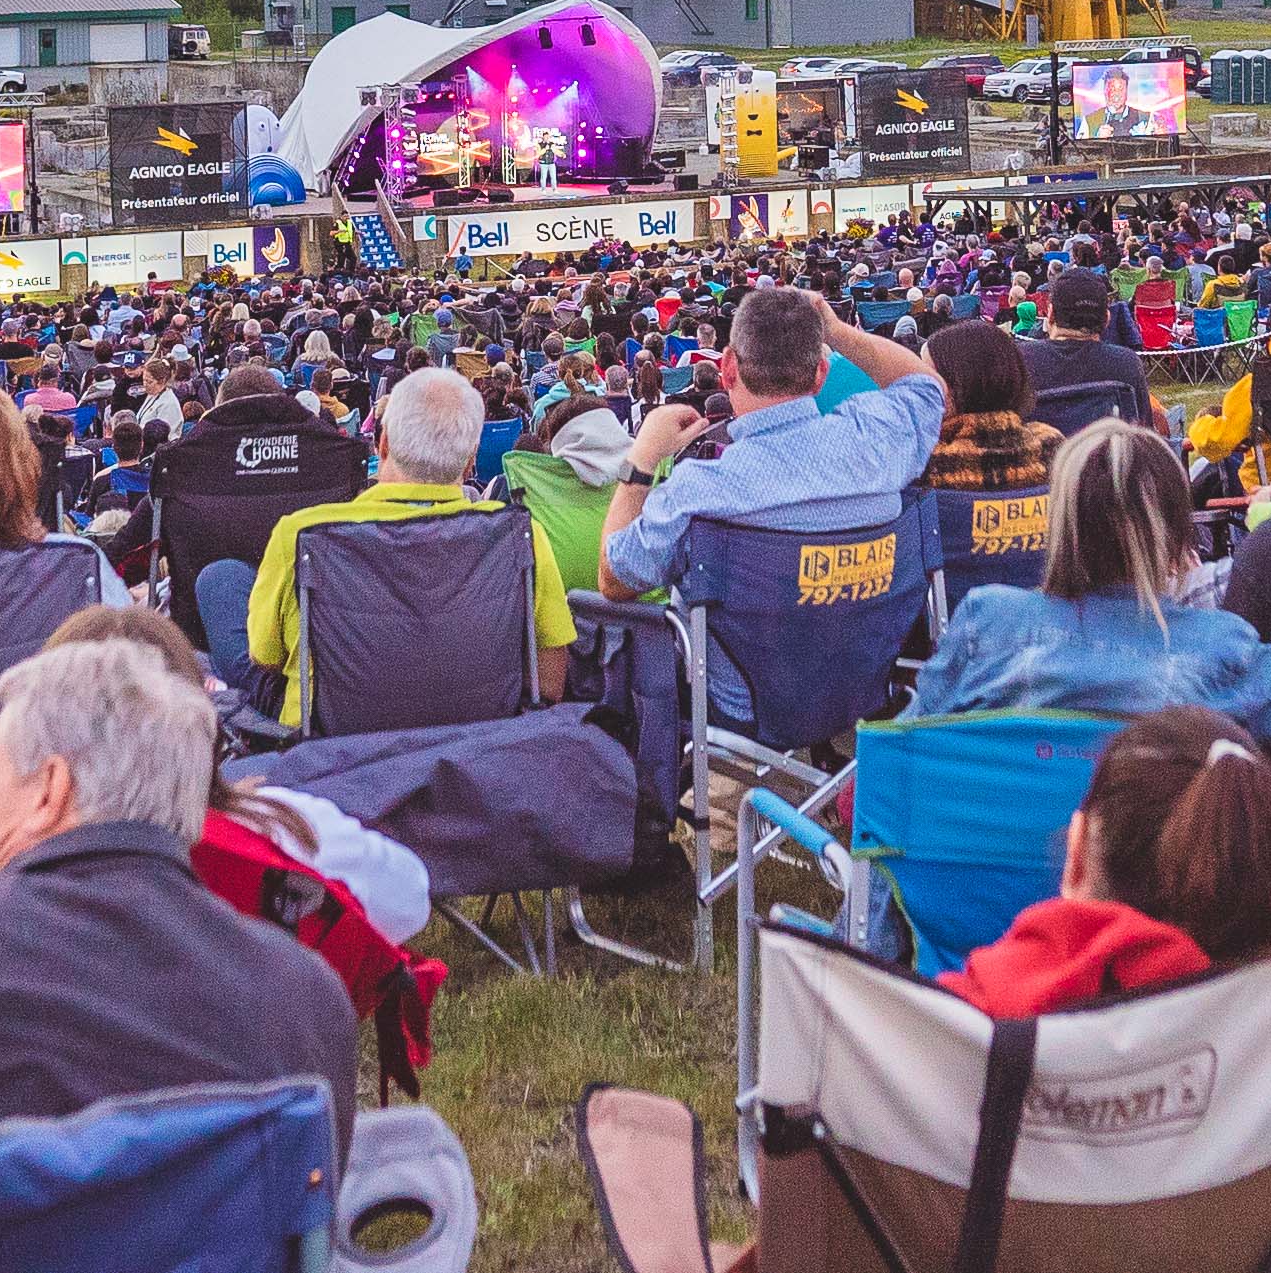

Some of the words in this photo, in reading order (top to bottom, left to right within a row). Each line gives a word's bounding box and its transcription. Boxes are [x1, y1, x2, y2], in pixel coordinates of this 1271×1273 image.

[875, 121, 919, 136] AGNICO
[920, 119, 956, 133] EAGLE
[869, 149, 930, 164] Présentateur
[930, 146, 963, 159] officiel
[129, 164, 185, 180] AGNICO
[187, 161, 231, 176] EAGLE
[121, 194, 198, 210] Présentateur
[199, 191, 240, 206] officiel
[468, 222, 509, 249] Bell
[536, 215, 614, 243] SCÈNE
[638, 210, 677, 237] Bell
[213, 241, 248, 264] Bell
[17, 276, 52, 288] EAGLE
[253, 434, 299, 447] FONDERIE
[253, 444, 299, 461] HORNE
[1006, 496, 1049, 521] BLAI
[838, 537, 894, 568] BLAIS
[1027, 1084, 1167, 1133] oleman
